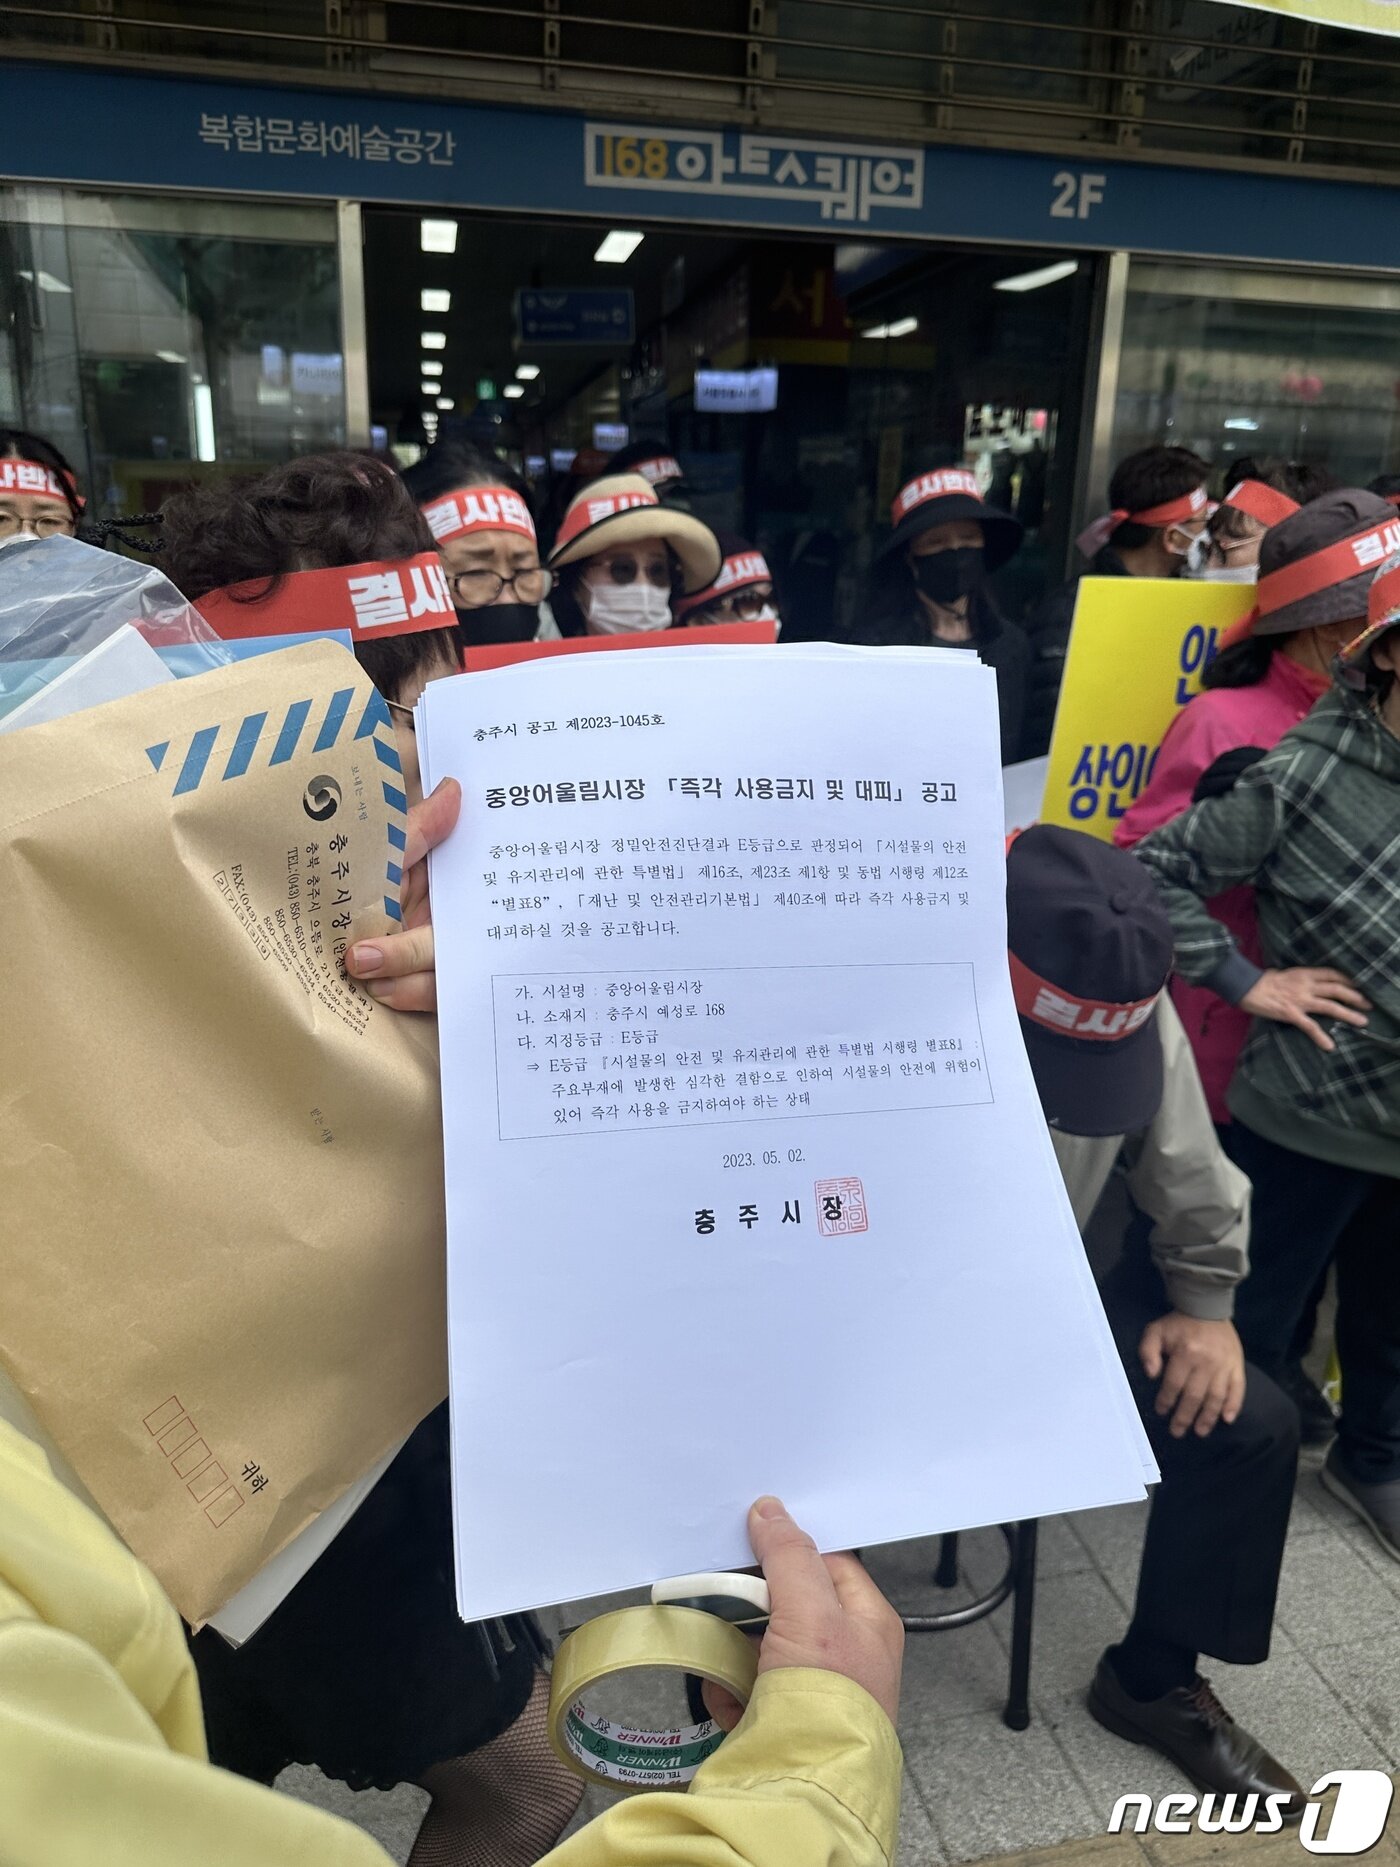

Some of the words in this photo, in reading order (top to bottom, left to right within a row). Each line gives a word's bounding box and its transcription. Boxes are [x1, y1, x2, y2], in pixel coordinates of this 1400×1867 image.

[198, 113, 457, 166] 복합문화예술공간
[1050, 171, 1107, 219] 2F
[472, 723, 518, 742] 충주시
[526, 721, 558, 735] 공고
[566, 713, 666, 732] 제2023-1045호
[485, 778, 646, 809] 중앙어울림시장
[668, 777, 723, 799] 「즉각
[735, 777, 815, 800] 사용금지
[826, 779, 844, 801] 및
[855, 780, 902, 802] 대피」
[921, 782, 958, 803] 공고
[305, 842, 321, 869] 충북
[489, 839, 601, 860] 중앙어울림시장
[611, 837, 730, 853] 정밀안전진단결과
[738, 838, 803, 853] E등급으로
[810, 838, 863, 853] 판정되어
[942, 840, 967, 854] 안전
[482, 871, 498, 887] 및
[507, 866, 585, 885] 유지관리에
[594, 865, 624, 881] 관한
[632, 864, 685, 881] 특별법」
[698, 865, 744, 880] 제16조,
[750, 865, 791, 879] 제23조
[798, 865, 831, 880] 제1항
[837, 865, 850, 880] 및
[857, 865, 882, 880] 동법
[888, 865, 926, 880] 시행령
[932, 865, 969, 880] 제12조
[306, 875, 322, 913] 충주시
[628, 892, 641, 908] 및
[773, 892, 828, 906] 제40조에
[834, 892, 861, 906] 따라
[868, 892, 894, 906] 즉각
[901, 892, 951, 906] 사용금지
[957, 892, 970, 906] 및
[487, 922, 552, 941] 대피하실
[561, 921, 593, 938] 것을
[601, 920, 681, 938] 공고합니다.
[514, 985, 534, 1000] 가.
[542, 983, 586, 999] 시설명
[604, 980, 704, 998] 중앙어울림시장
[516, 1009, 535, 1025] 나.
[543, 1007, 588, 1024] 소재지
[606, 1005, 649, 1022] 충주시
[656, 1003, 699, 1019] 예성로
[704, 1003, 726, 1017] 168
[517, 1034, 536, 1050] 다.
[544, 1031, 603, 1049] 지정등급
[620, 1029, 660, 1045] E등급
[549, 1056, 588, 1073] E등급
[675, 1051, 702, 1067] 안전
[711, 1050, 724, 1065] 및
[732, 1046, 797, 1063] 유지관리에
[805, 1043, 831, 1060] 관한
[838, 1042, 875, 1058] 특별법
[882, 1039, 918, 1055] 시행령
[551, 1079, 624, 1099] 주요부재에
[634, 1076, 677, 1094] 발생한
[685, 1072, 727, 1090] 심각한
[735, 1069, 788, 1088] 결함으로
[796, 1066, 834, 1084] 인하여
[842, 1063, 892, 1080] 시설물의
[899, 1060, 937, 1077] 안전에
[945, 1058, 982, 1075] 위험이
[553, 1107, 583, 1125] 있어
[590, 1105, 620, 1121] 즉각
[627, 1100, 671, 1118] 사용을
[676, 1095, 747, 1115] 금지하여야
[752, 1094, 779, 1109] 하는
[785, 1091, 811, 1107] 상태
[722, 1152, 756, 1169] 2023.
[762, 1149, 782, 1165] 05.
[787, 1148, 807, 1163] 02.
[241, 1460, 270, 1495] 귀하
[617, 1732, 682, 1746] WINNER
[616, 1754, 682, 1768] WINNER
[666, 1770, 682, 1779] TEL
